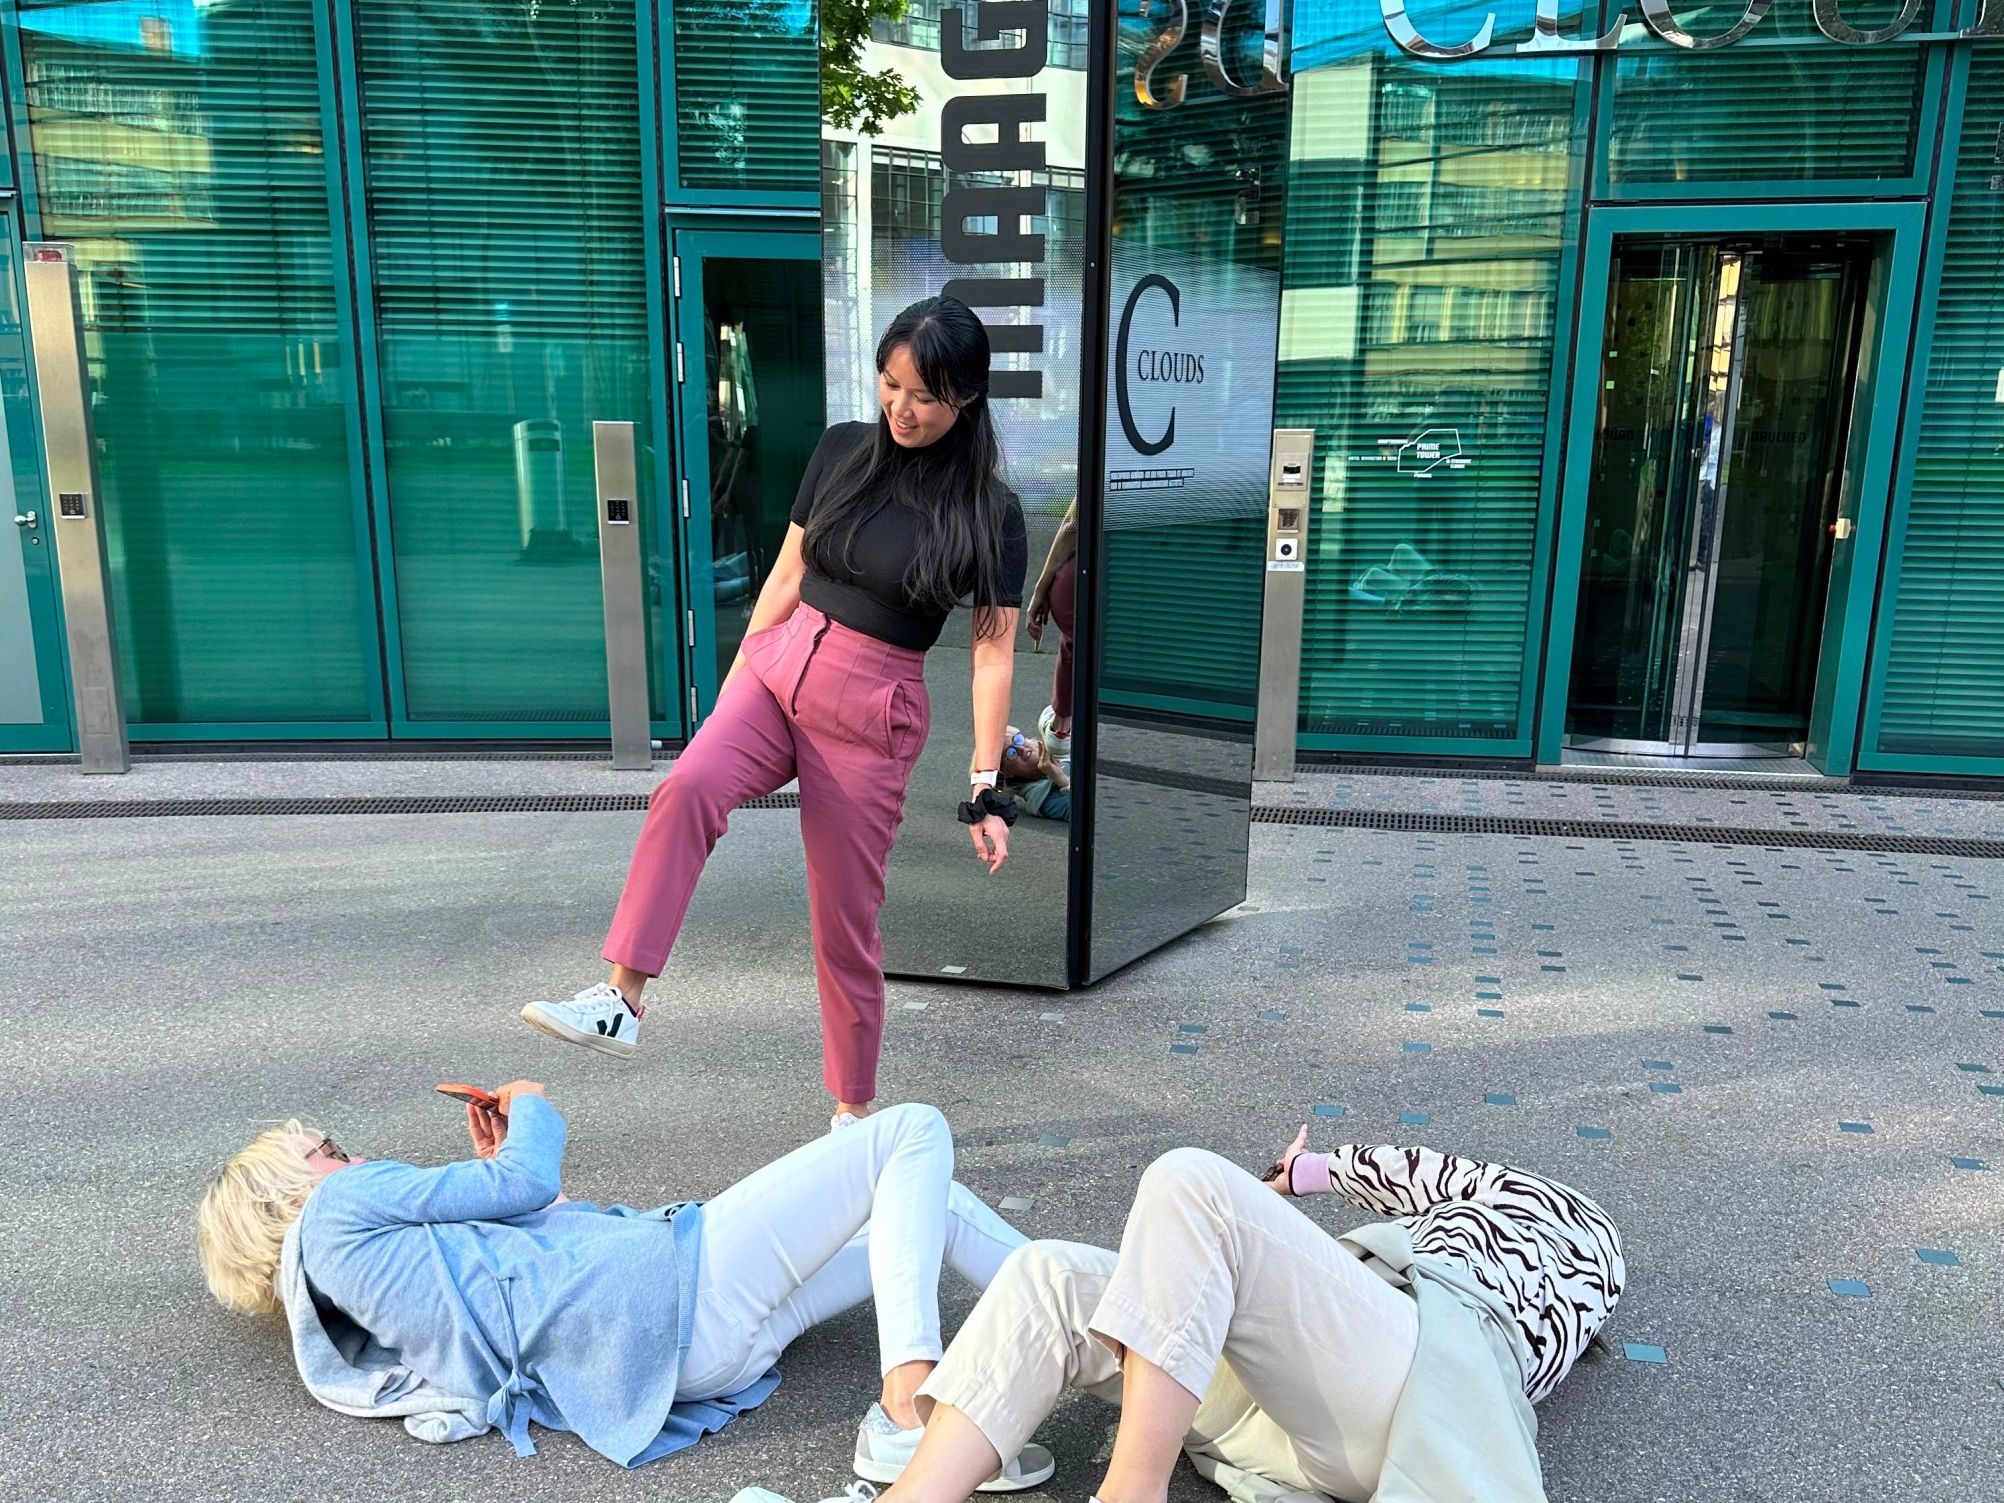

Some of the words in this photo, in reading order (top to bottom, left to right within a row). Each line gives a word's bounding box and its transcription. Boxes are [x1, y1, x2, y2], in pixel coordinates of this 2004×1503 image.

[1137, 349, 1206, 385] CLOUDS
[1416, 443, 1440, 451] PRIME
[1416, 451, 1441, 459] TOWER
